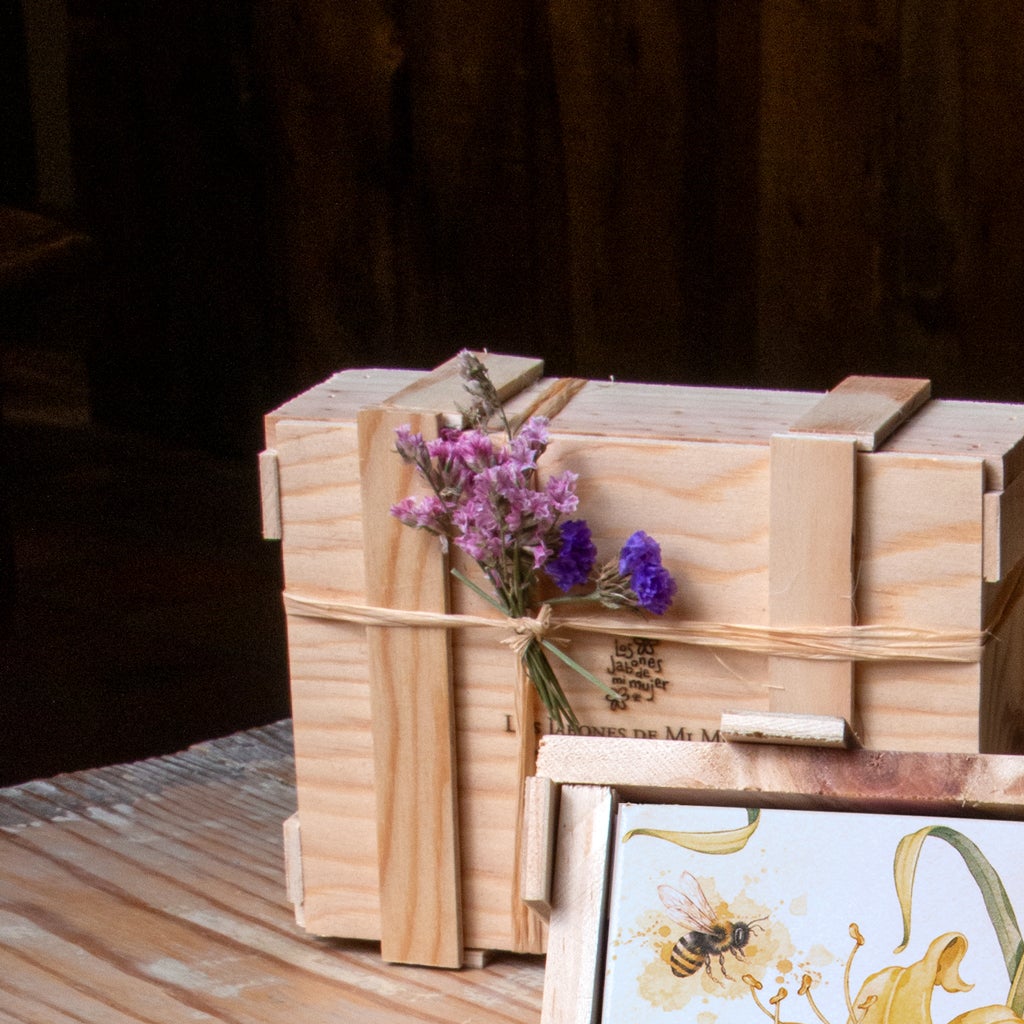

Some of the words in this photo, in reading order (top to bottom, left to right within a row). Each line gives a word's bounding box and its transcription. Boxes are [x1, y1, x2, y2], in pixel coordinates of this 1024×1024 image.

[615, 639, 633, 658] Los
[607, 655, 662, 674] Jabones
[636, 668, 650, 678] de
[612, 676, 626, 684] mi
[629, 678, 669, 701] mujer
